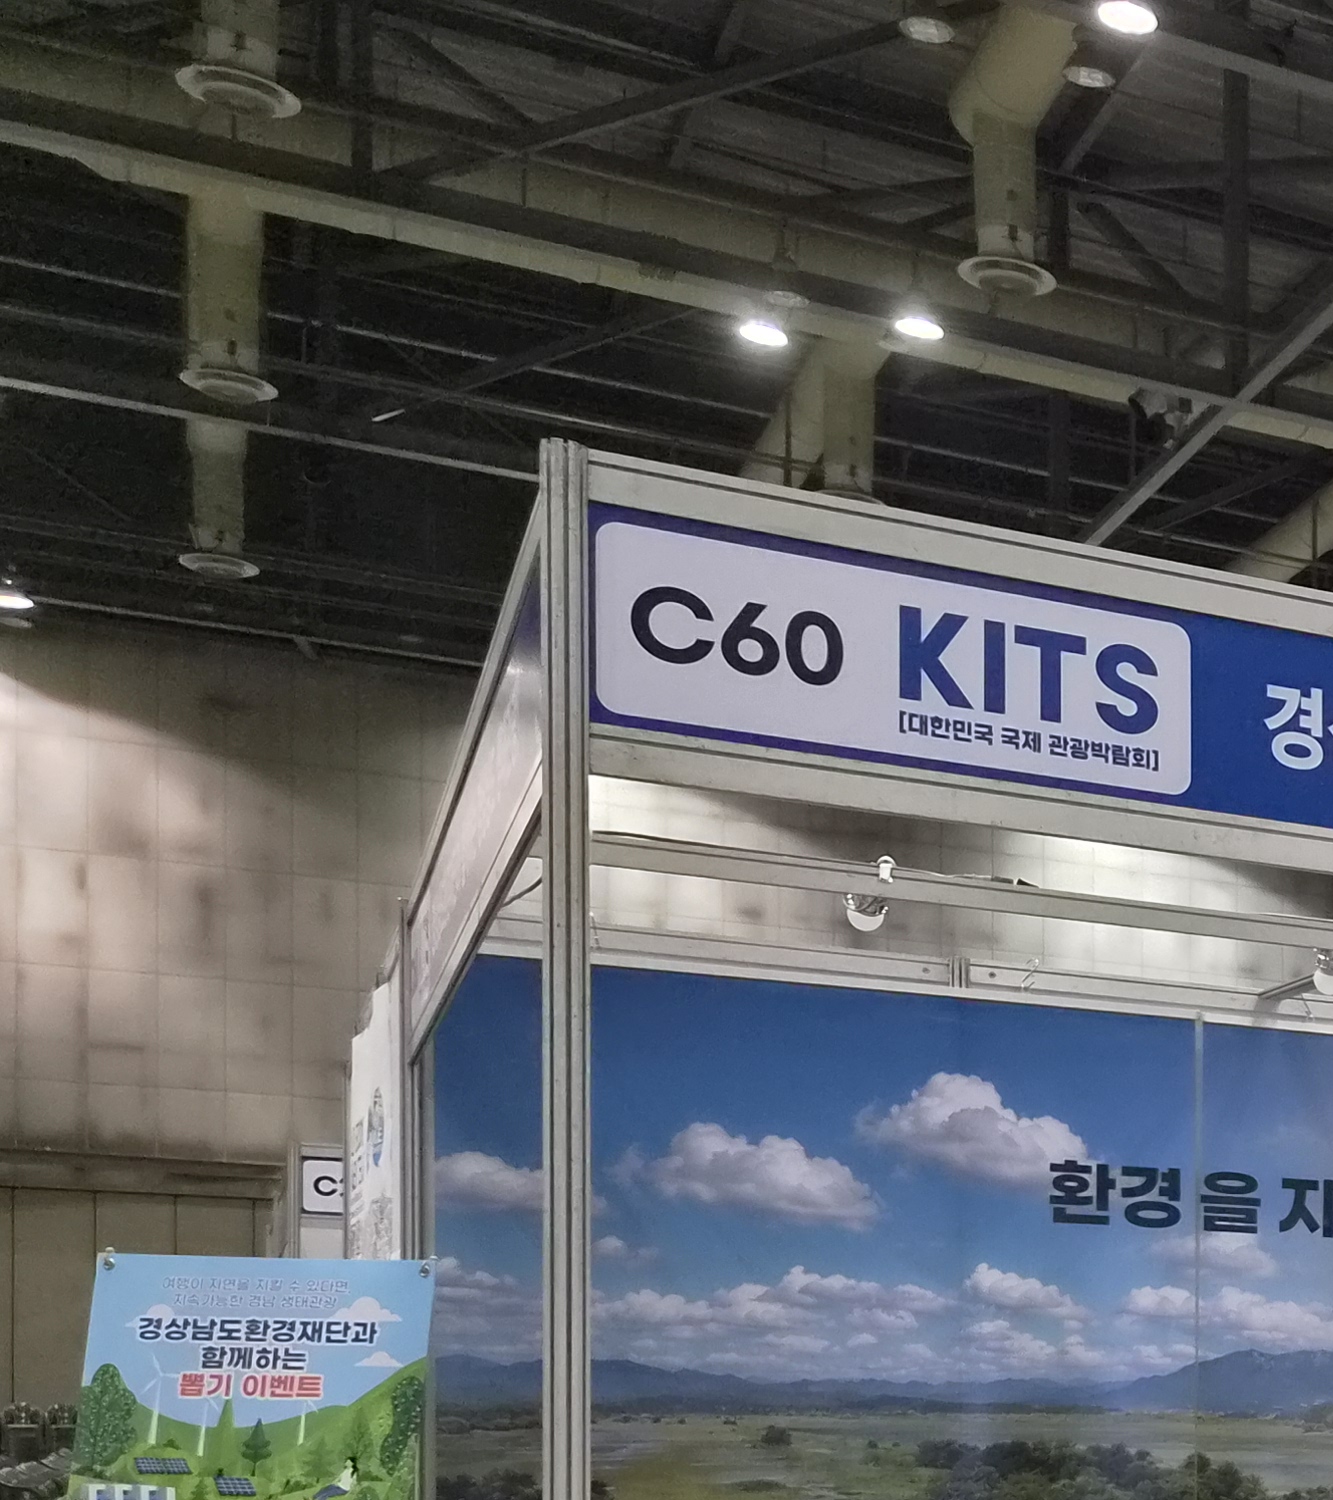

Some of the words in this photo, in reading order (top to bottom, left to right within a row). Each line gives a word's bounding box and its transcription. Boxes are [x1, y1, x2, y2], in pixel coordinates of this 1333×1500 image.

[630, 585, 844, 687] C60
[898, 604, 1160, 735] KITS
[898, 709, 994, 746] [대한민국
[1000, 726, 1042, 754] 국제
[1048, 733, 1160, 772] 관광박람회]
[138, 1317, 378, 1345] 경상남도환경재단과
[201, 1345, 308, 1371] 함께하는
[180, 1373, 233, 1397] 뽑기
[242, 1374, 323, 1398] 이벤트
